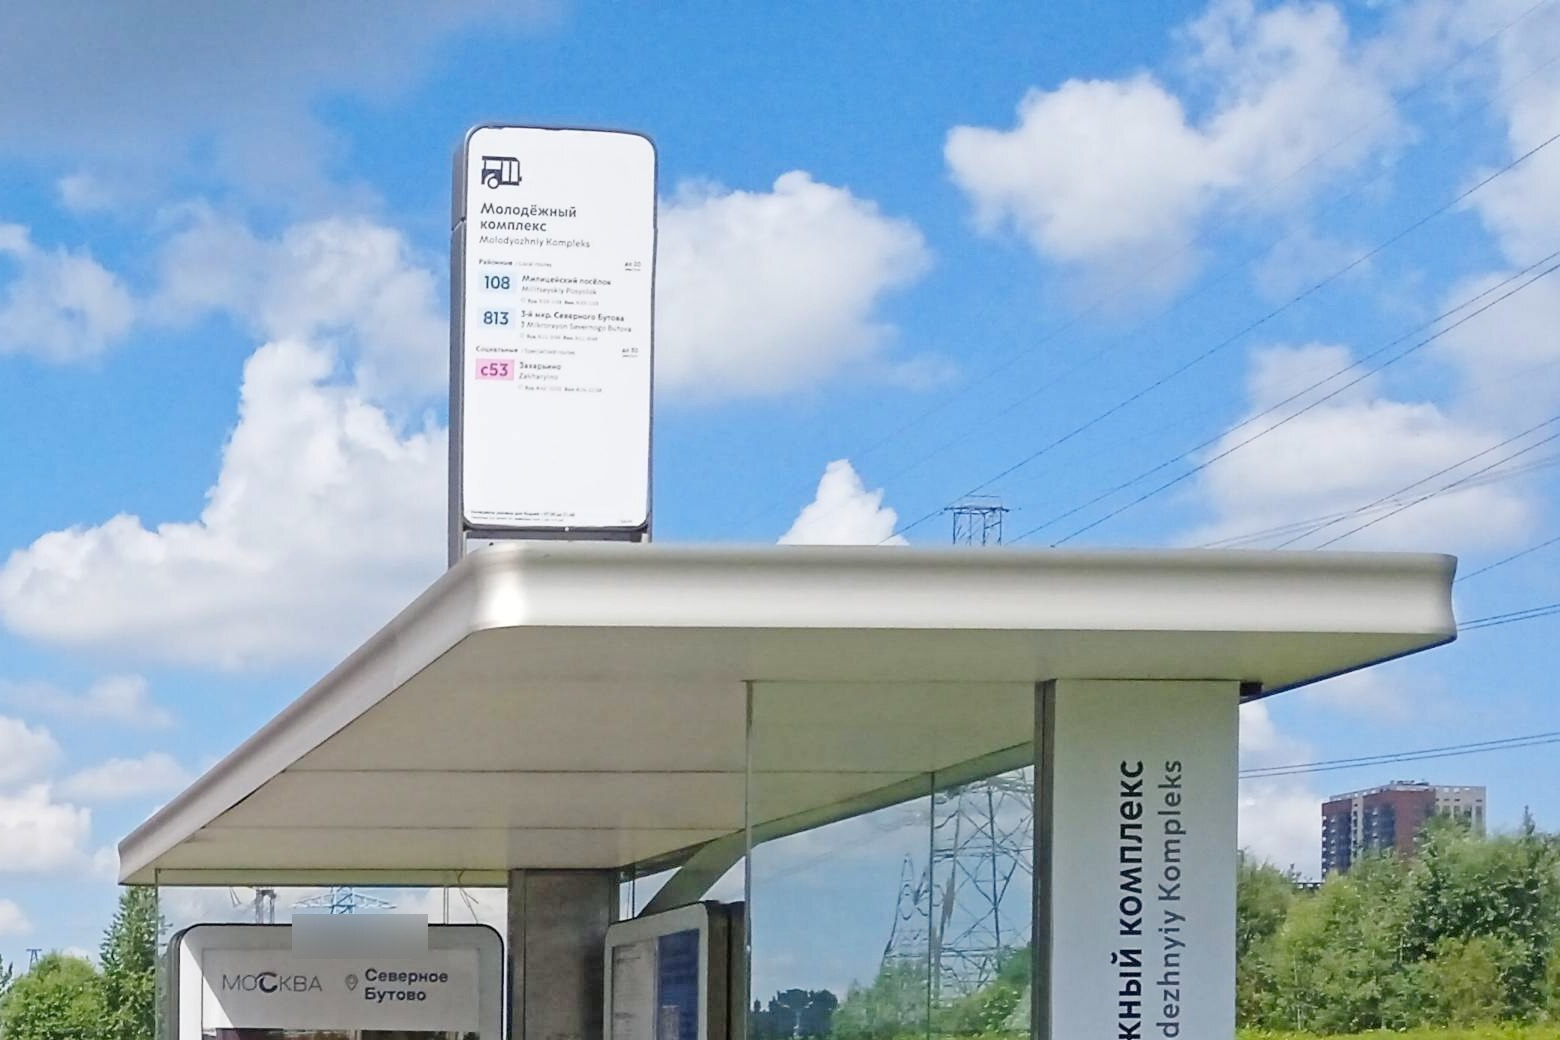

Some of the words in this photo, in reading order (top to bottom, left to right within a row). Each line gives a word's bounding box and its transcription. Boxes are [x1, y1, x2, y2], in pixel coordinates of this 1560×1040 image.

[480, 202, 577, 218] Молодёжный
[480, 221, 547, 232] комплекс
[484, 275, 511, 290] 108
[483, 311, 509, 326] 813
[1157, 760, 1186, 901] Kompleks
[1120, 760, 1143, 936] комплекс
[222, 971, 322, 993] МОСКВА
[364, 968, 449, 984] Северное
[364, 987, 427, 1003] Бутово
